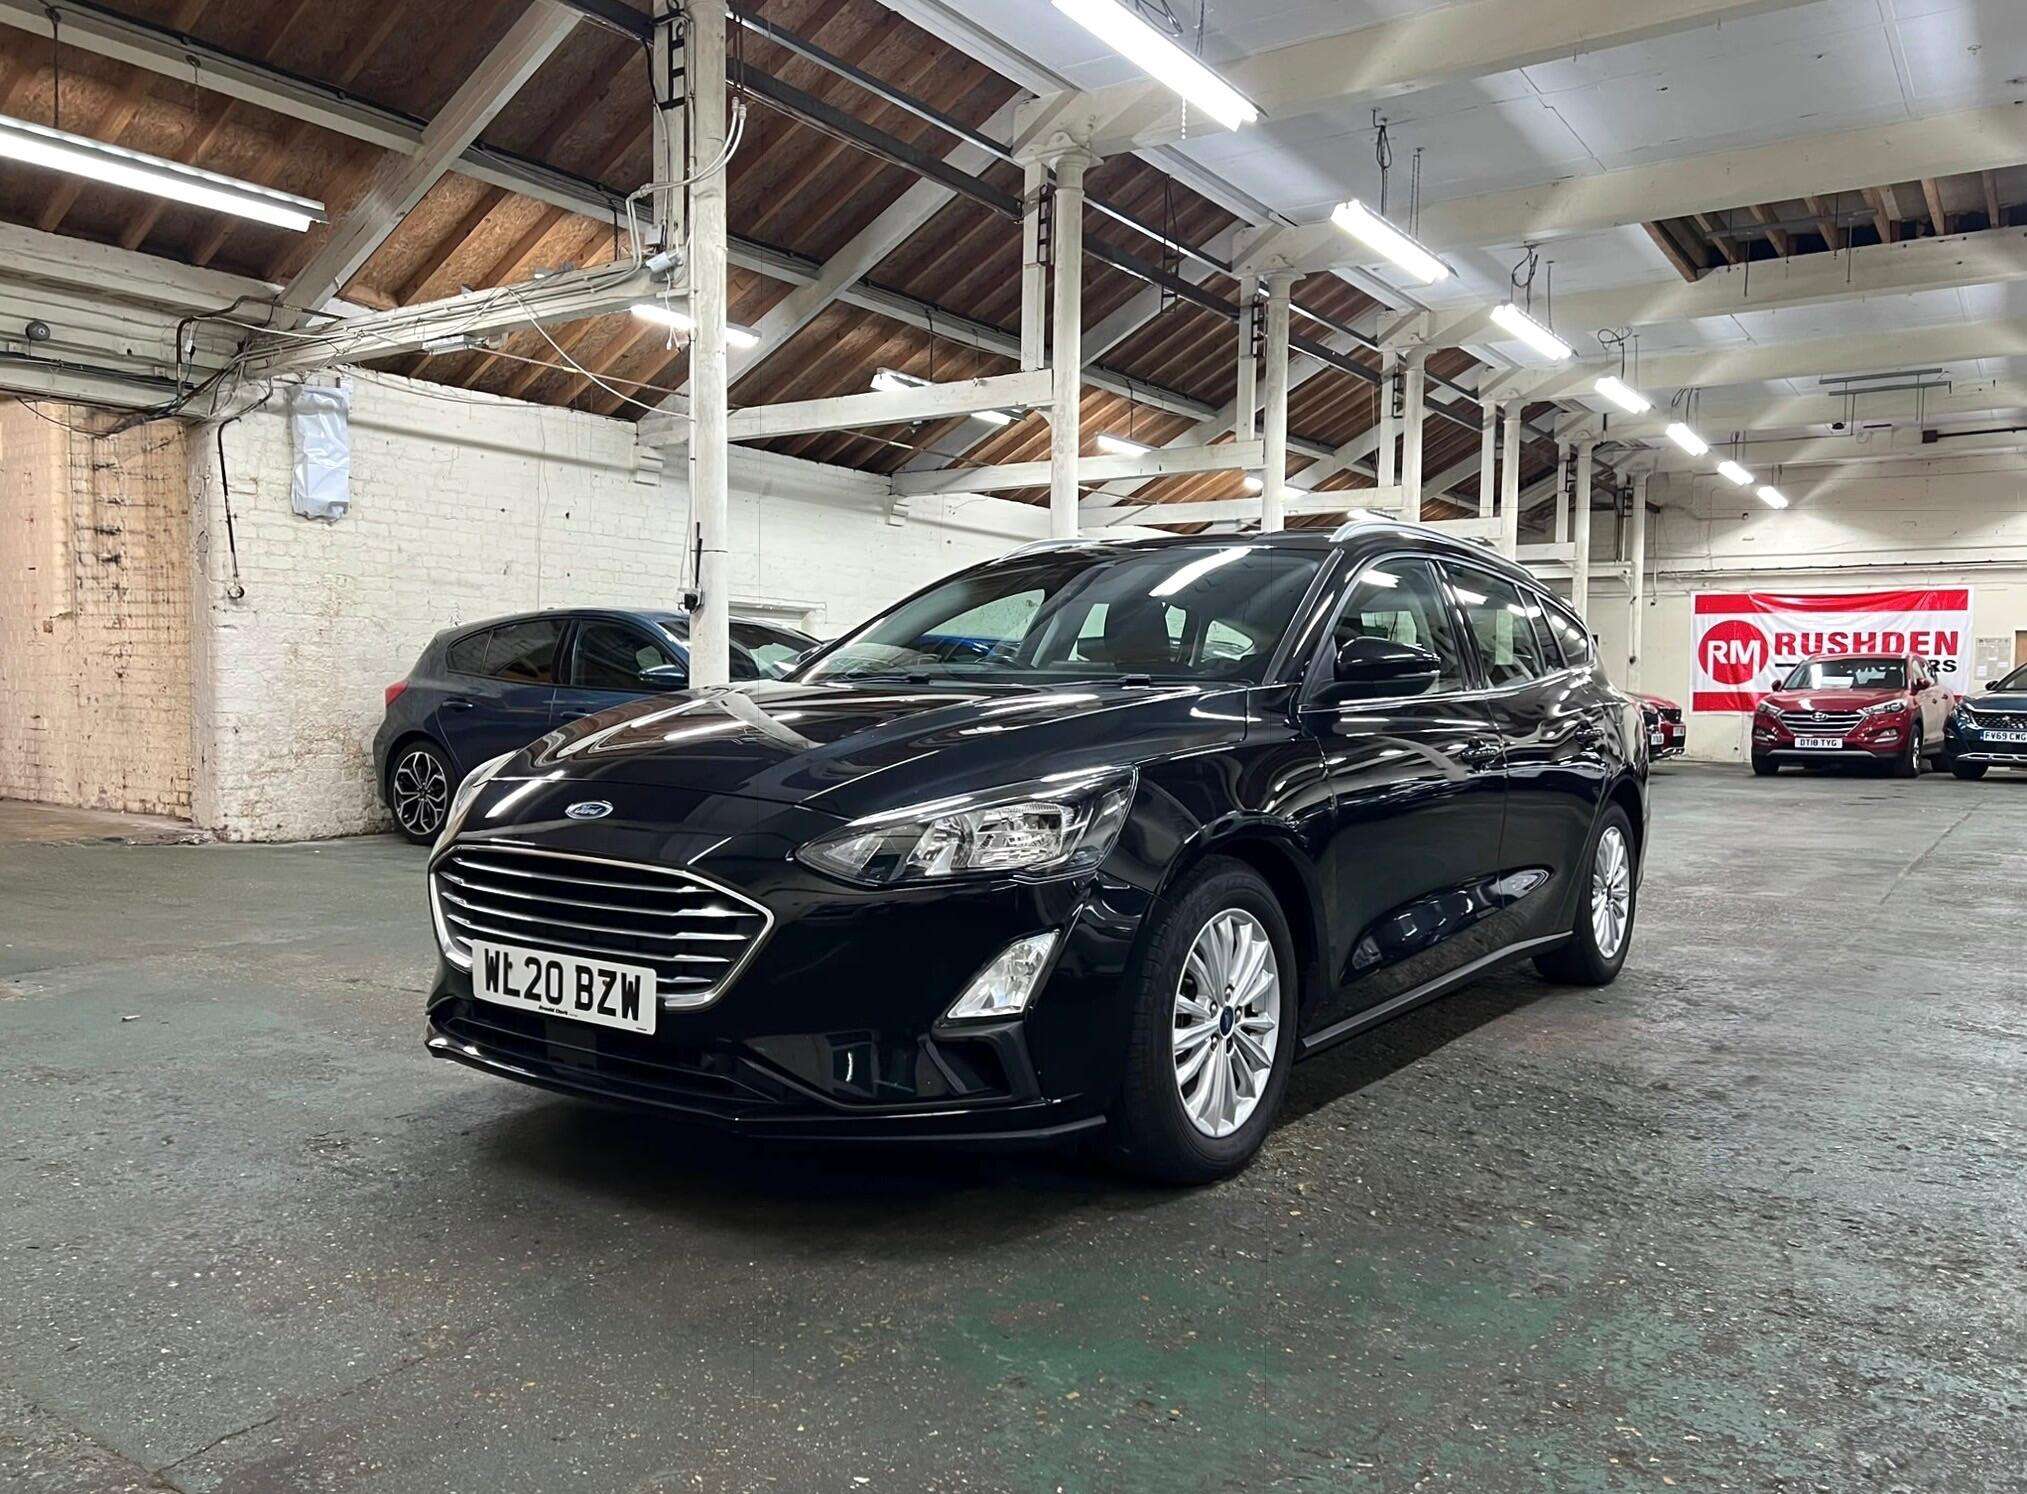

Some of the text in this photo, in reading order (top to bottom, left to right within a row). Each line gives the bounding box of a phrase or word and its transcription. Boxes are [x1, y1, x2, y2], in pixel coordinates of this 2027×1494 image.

[1707, 639, 1761, 676] RM
[1775, 631, 1958, 656] RUSHDEN
[485, 948, 641, 1021] WL20 BZW
